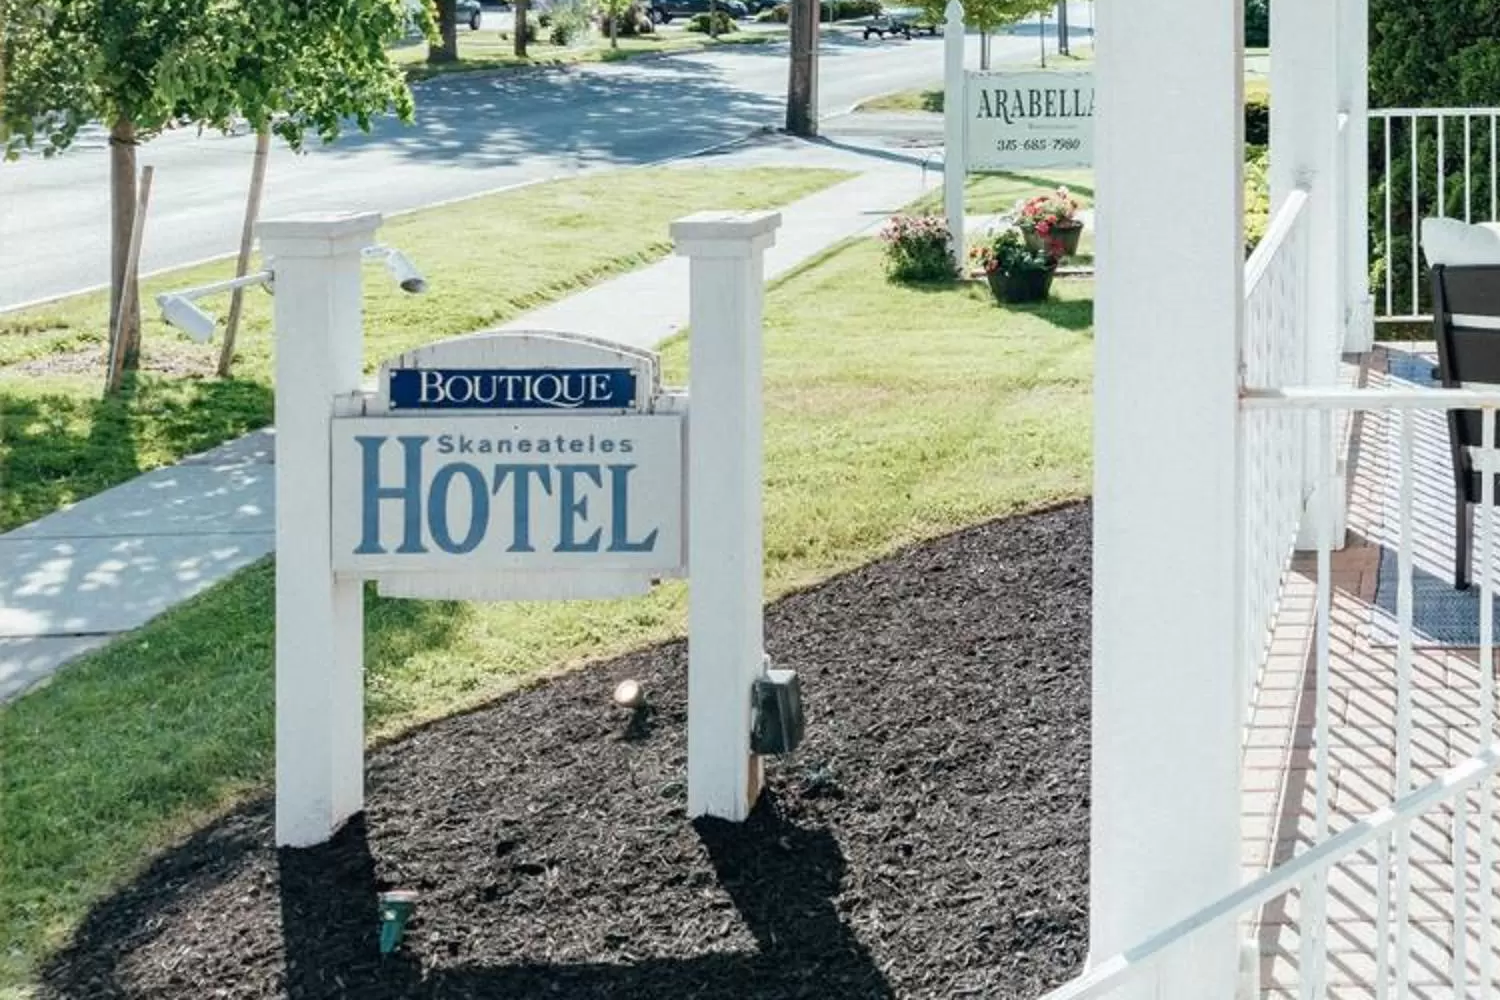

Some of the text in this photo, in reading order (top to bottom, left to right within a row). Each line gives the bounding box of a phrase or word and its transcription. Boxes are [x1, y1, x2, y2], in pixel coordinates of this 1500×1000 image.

[419, 371, 613, 408] BOUTIQUE
[437, 434, 633, 454] Skaneateles
[353, 435, 658, 555] HOTEL
